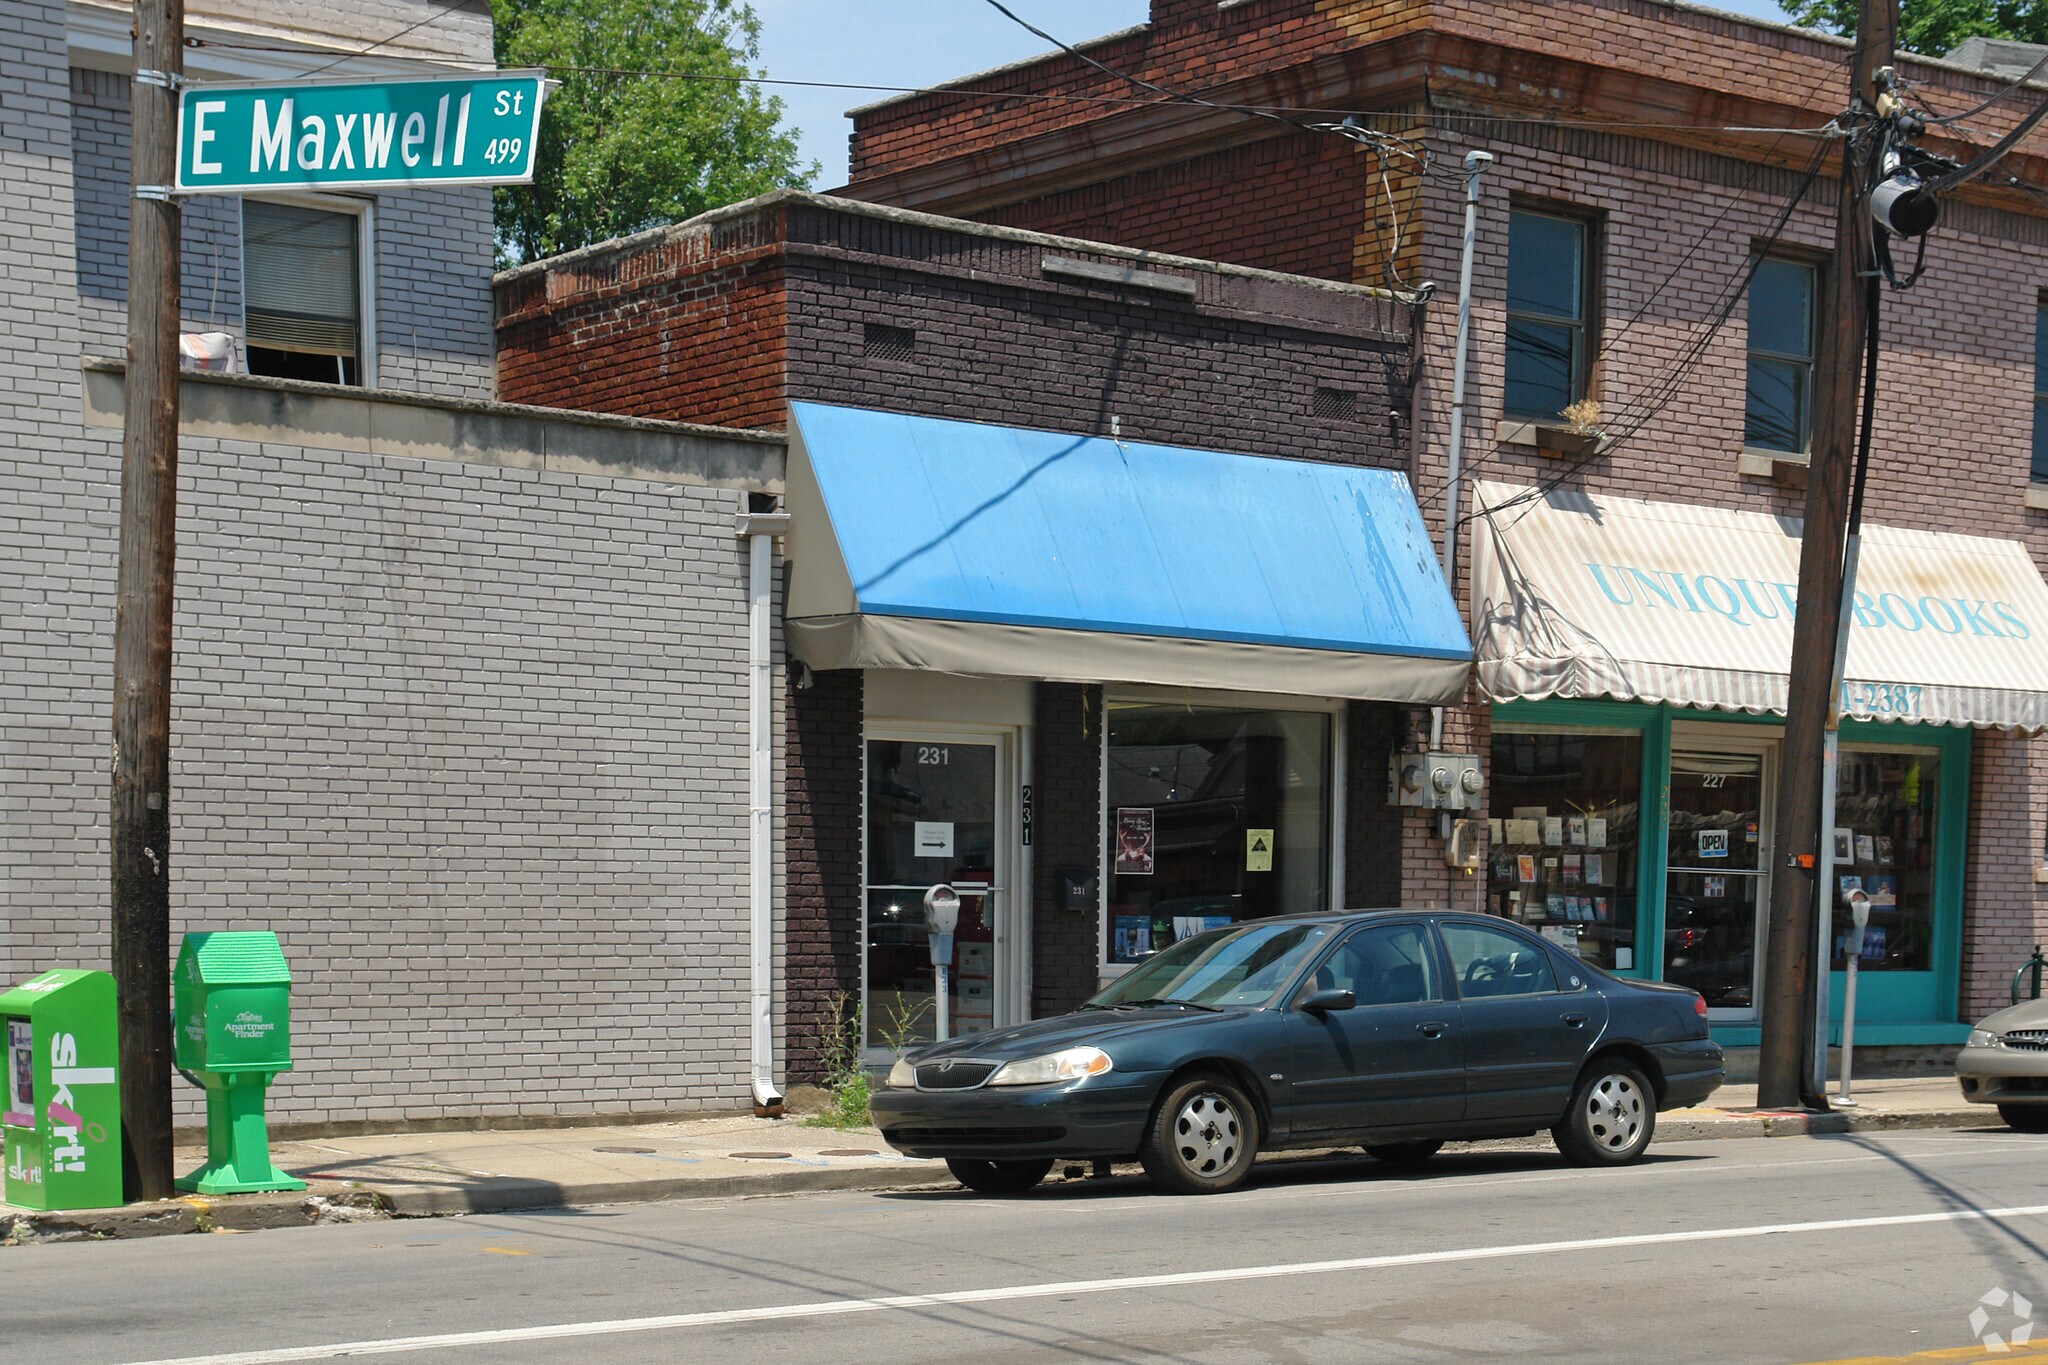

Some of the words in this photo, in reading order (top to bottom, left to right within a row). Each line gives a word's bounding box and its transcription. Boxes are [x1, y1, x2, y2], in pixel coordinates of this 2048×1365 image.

[192, 101, 226, 175] E
[249, 92, 472, 172] Maxwell
[494, 89, 524, 116] St
[484, 138, 522, 165] 499
[1852, 591, 2031, 640] BOOKS
[918, 747, 949, 765] 231
[1702, 773, 1727, 788] 227
[1023, 788, 1031, 844] 231
[1702, 835, 1725, 850] OPEN
[1072, 887, 1086, 895] 231
[224, 1023, 275, 1033] Apartment
